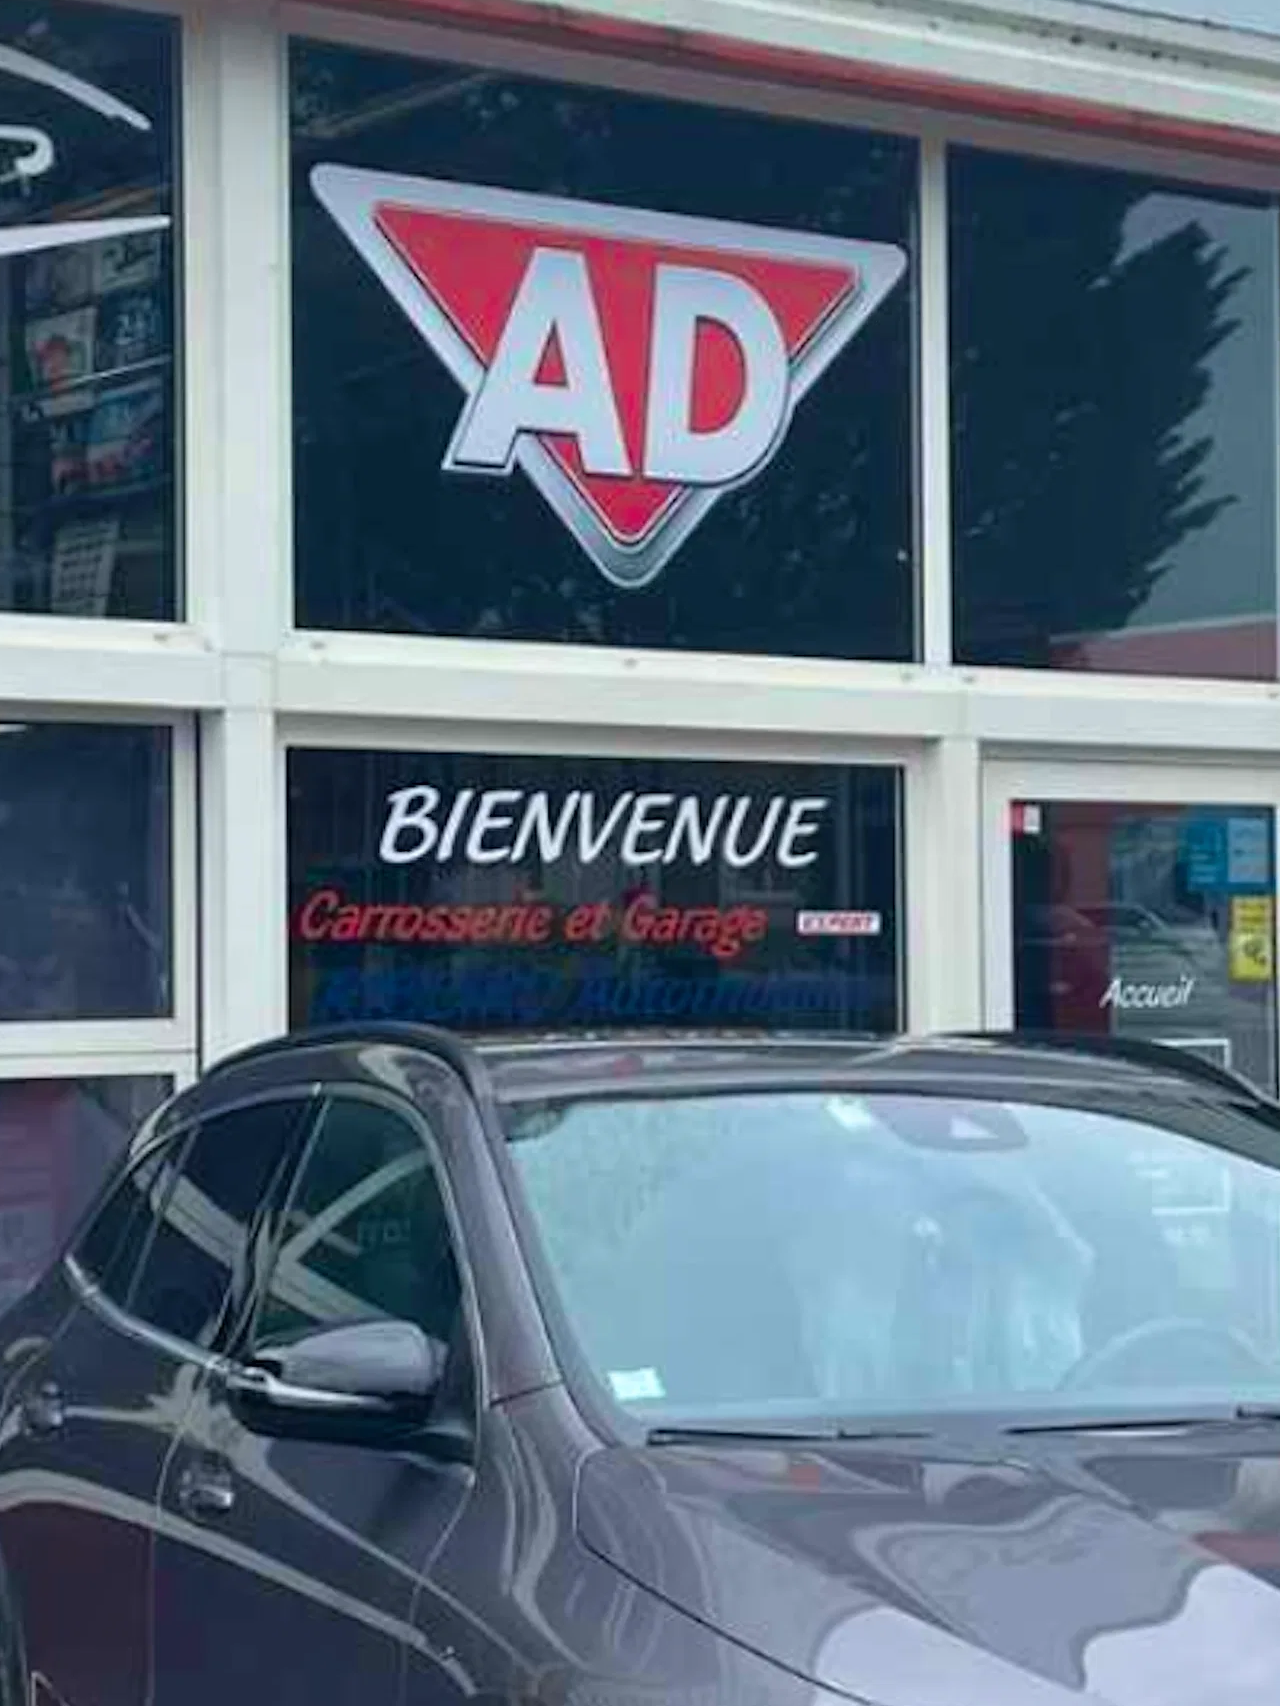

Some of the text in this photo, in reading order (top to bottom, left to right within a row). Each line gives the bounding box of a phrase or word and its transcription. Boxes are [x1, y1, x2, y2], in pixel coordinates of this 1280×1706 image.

[441, 246, 792, 492] AD
[379, 784, 829, 867] BIENVENUE
[299, 889, 768, 957] Carrosserie et Garage
[1099, 973, 1196, 1009] Accueil
